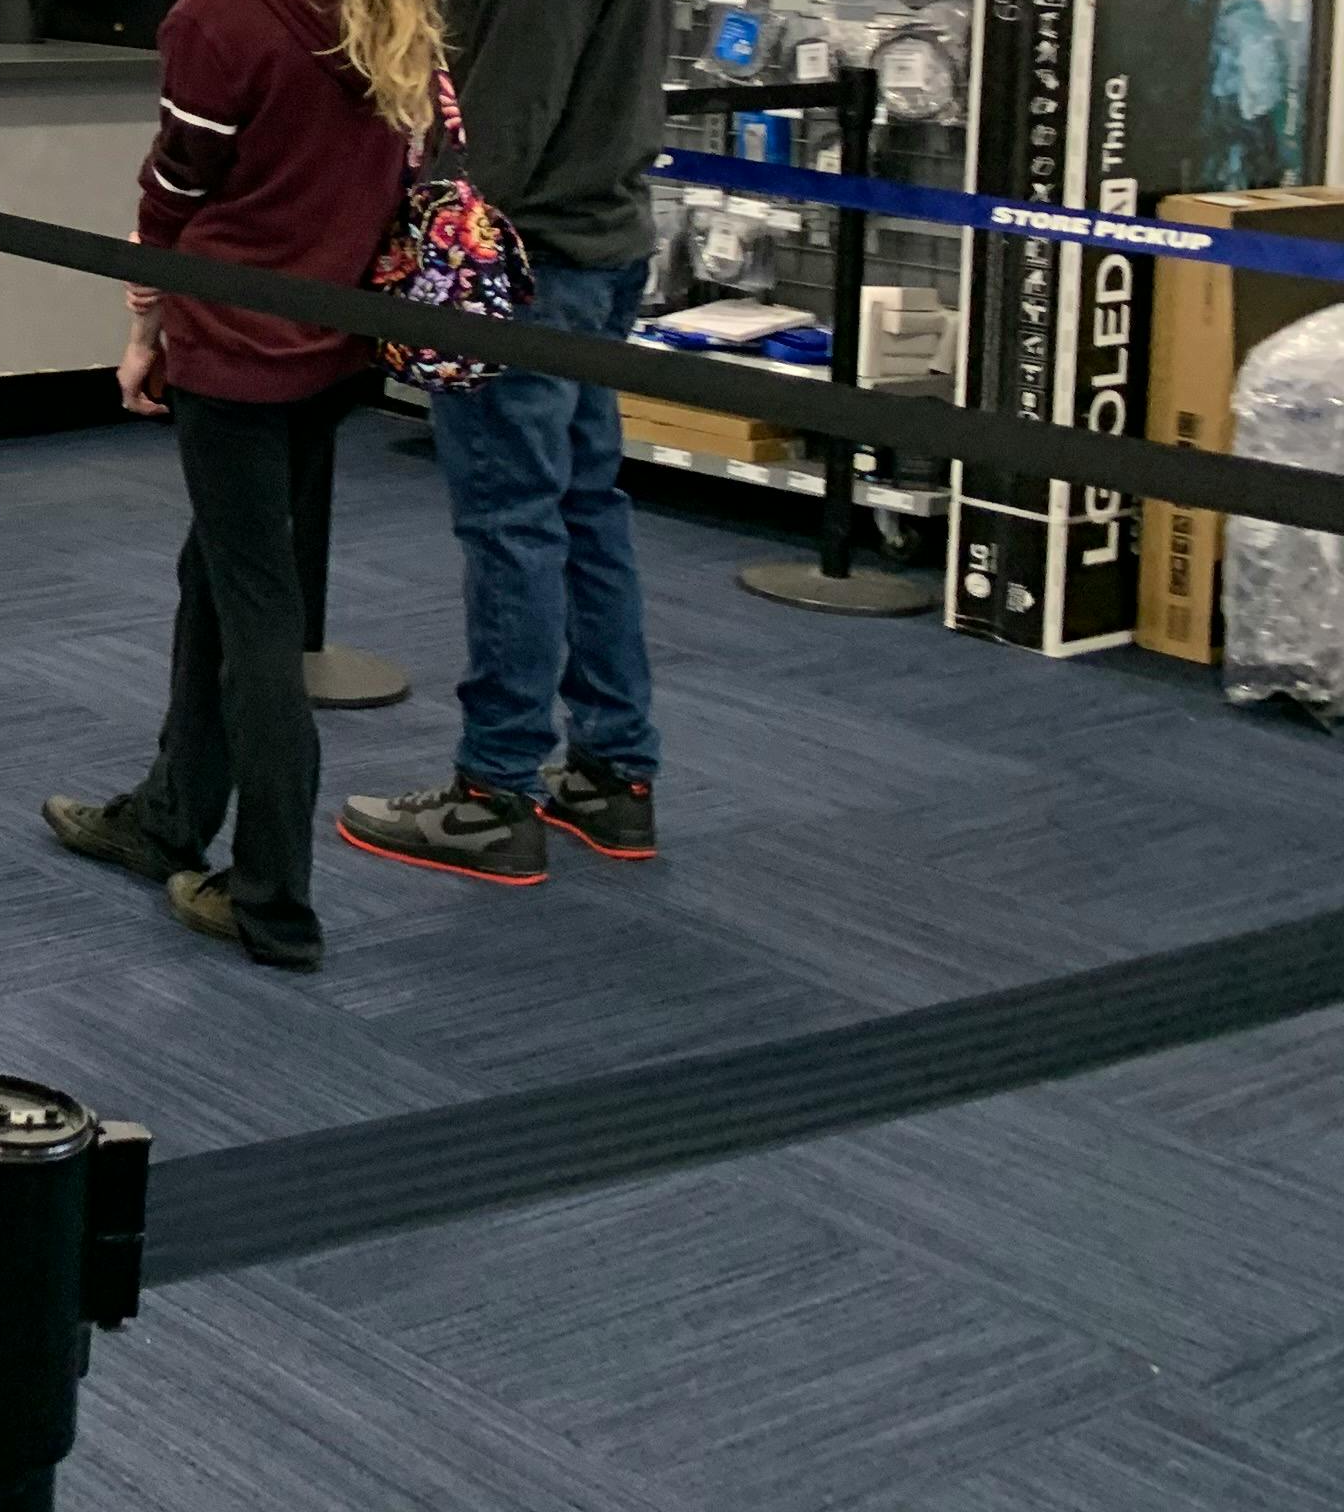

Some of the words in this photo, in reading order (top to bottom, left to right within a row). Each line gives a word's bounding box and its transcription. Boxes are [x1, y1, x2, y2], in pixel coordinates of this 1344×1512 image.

[1101, 74, 1129, 172] ThinQ
[990, 205, 1090, 236] STORE
[1093, 218, 1213, 252] PICKUP
[1089, 253, 1133, 436] OLED
[968, 543, 990, 572] LG
[1081, 485, 1122, 566] LG
